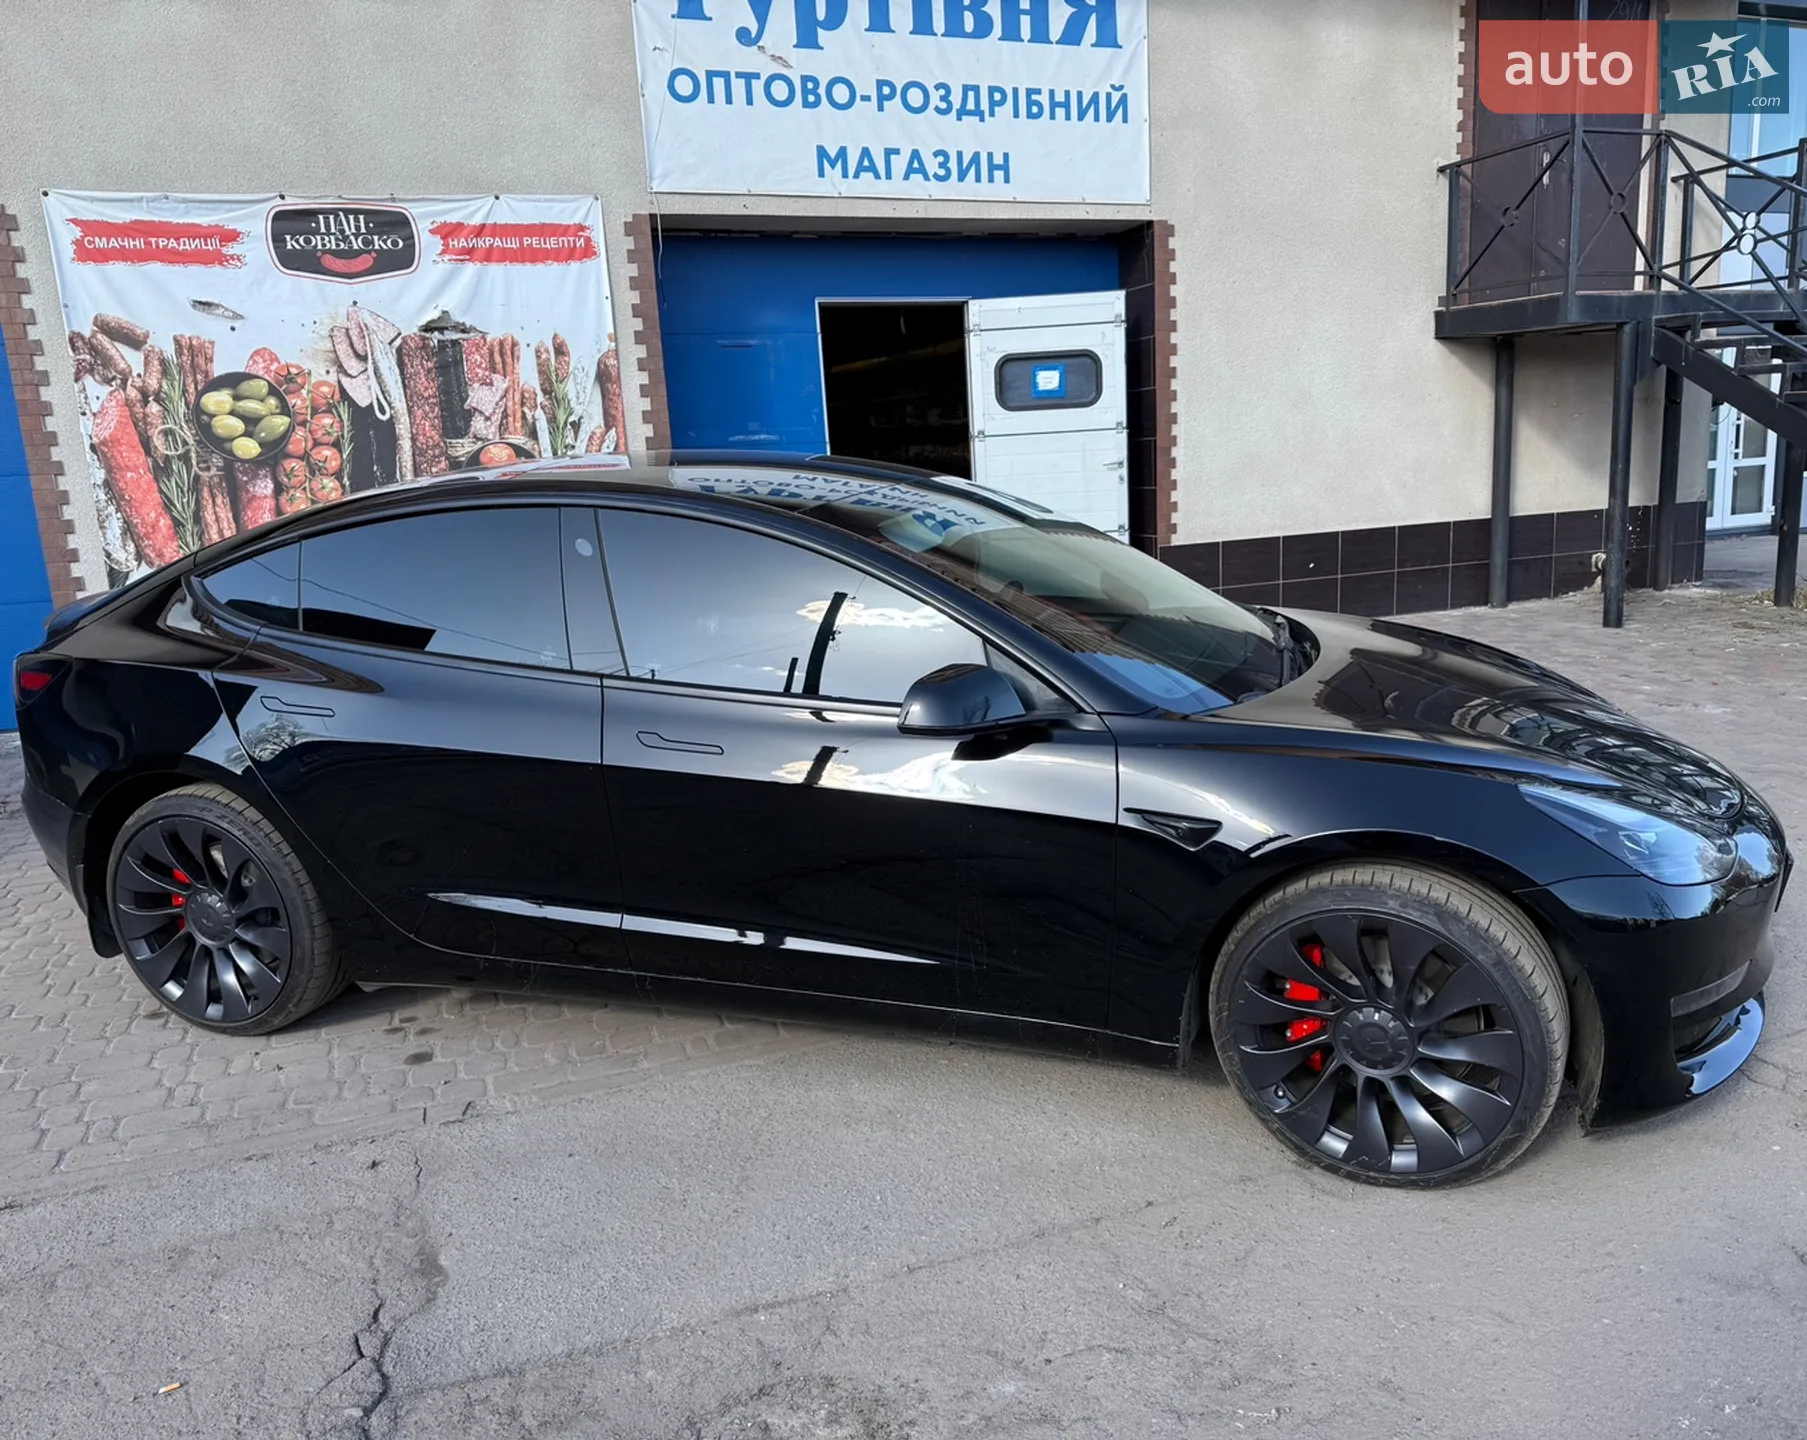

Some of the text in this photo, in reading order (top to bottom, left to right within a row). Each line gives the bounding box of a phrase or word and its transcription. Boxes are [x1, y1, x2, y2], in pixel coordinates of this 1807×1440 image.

[666, 66, 1130, 124] ОПТОВО-РОЗДРІБНИЙ
[815, 144, 1011, 184] МАГАЗИН
[316, 211, 367, 235] ПАН
[84, 235, 221, 251] СМАЧНІ ТРАДИЦІЇ
[449, 235, 585, 249] НАЙКРАЩІ РЕЦЕПТИ
